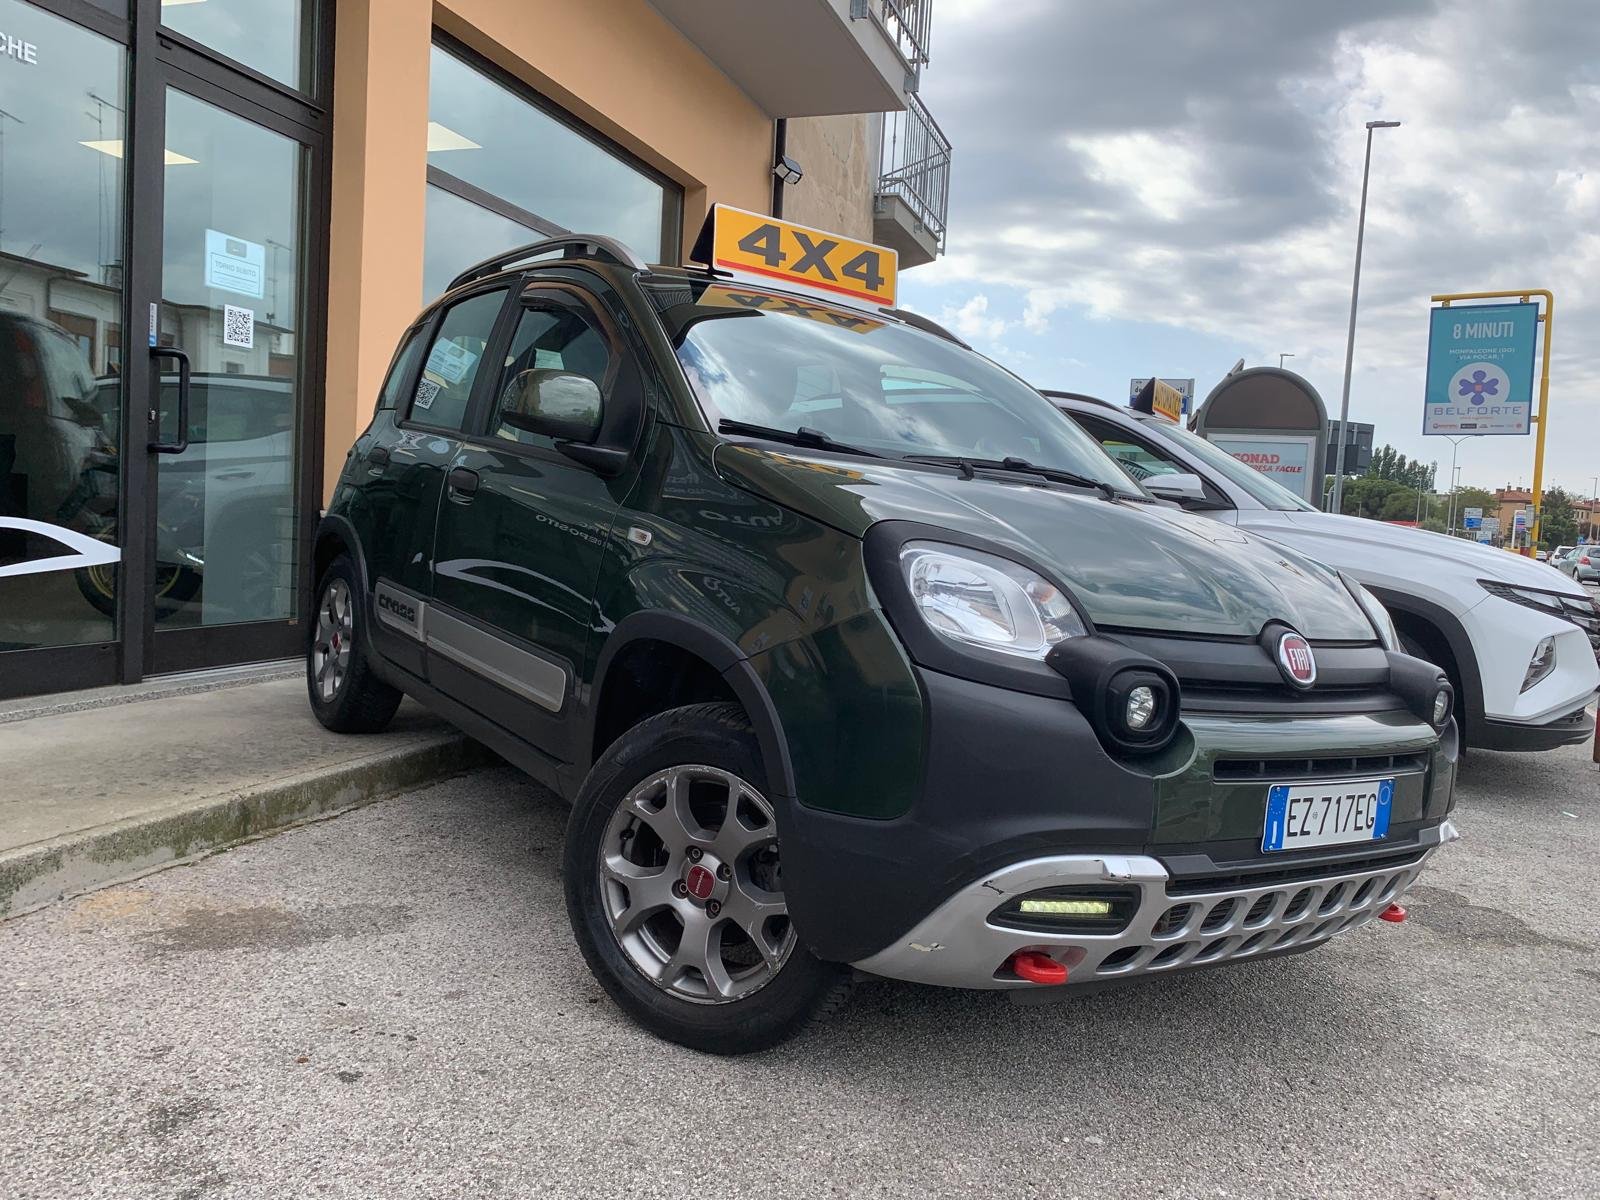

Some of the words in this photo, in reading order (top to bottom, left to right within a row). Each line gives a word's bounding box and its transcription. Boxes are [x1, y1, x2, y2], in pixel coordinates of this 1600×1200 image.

[738, 224, 885, 292] 4X4
[1453, 323, 1461, 339] 8
[1465, 321, 1514, 339] MINUTI
[1434, 406, 1522, 415] BELFORTE
[1275, 465, 1302, 473] FACILE
[1288, 647, 1310, 671] FIAT
